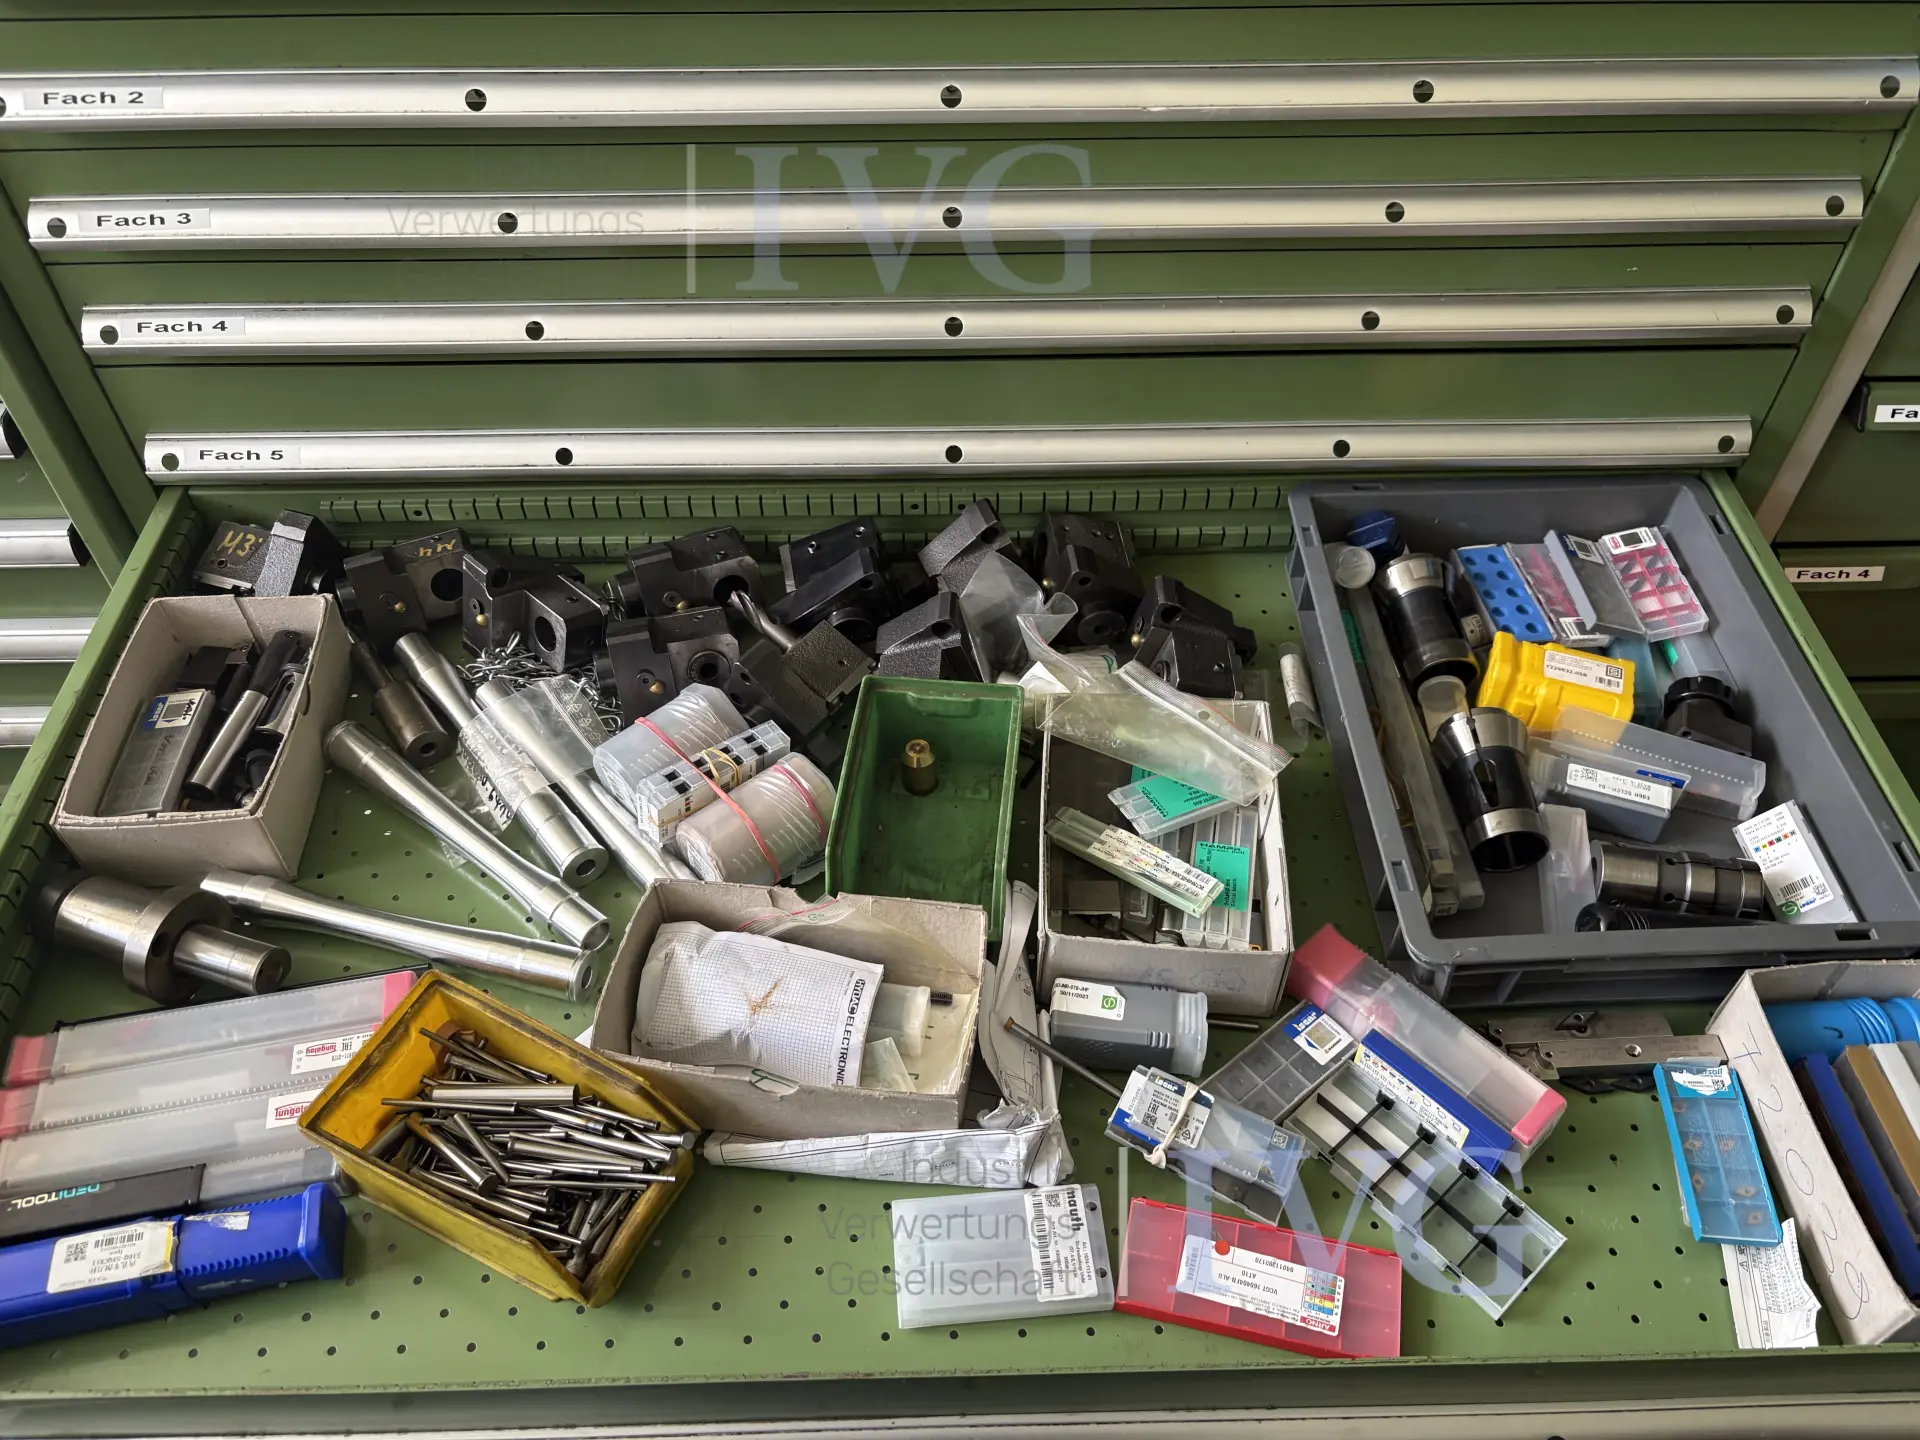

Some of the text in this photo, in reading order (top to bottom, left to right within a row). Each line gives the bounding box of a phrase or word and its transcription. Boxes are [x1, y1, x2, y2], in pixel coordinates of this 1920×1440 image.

[43, 91, 144, 105] Fach 2
[96, 212, 192, 227] Fach 3
[137, 320, 228, 333] Fach 4
[1890, 408, 1920, 419] Fa
[199, 449, 284, 461] Fach 5
[1797, 569, 1871, 580] Fach 4
[847, 977, 865, 1015] HYDAC
[273, 1103, 309, 1118] Tungal
[1304, 1317, 1331, 1330] ARNO
